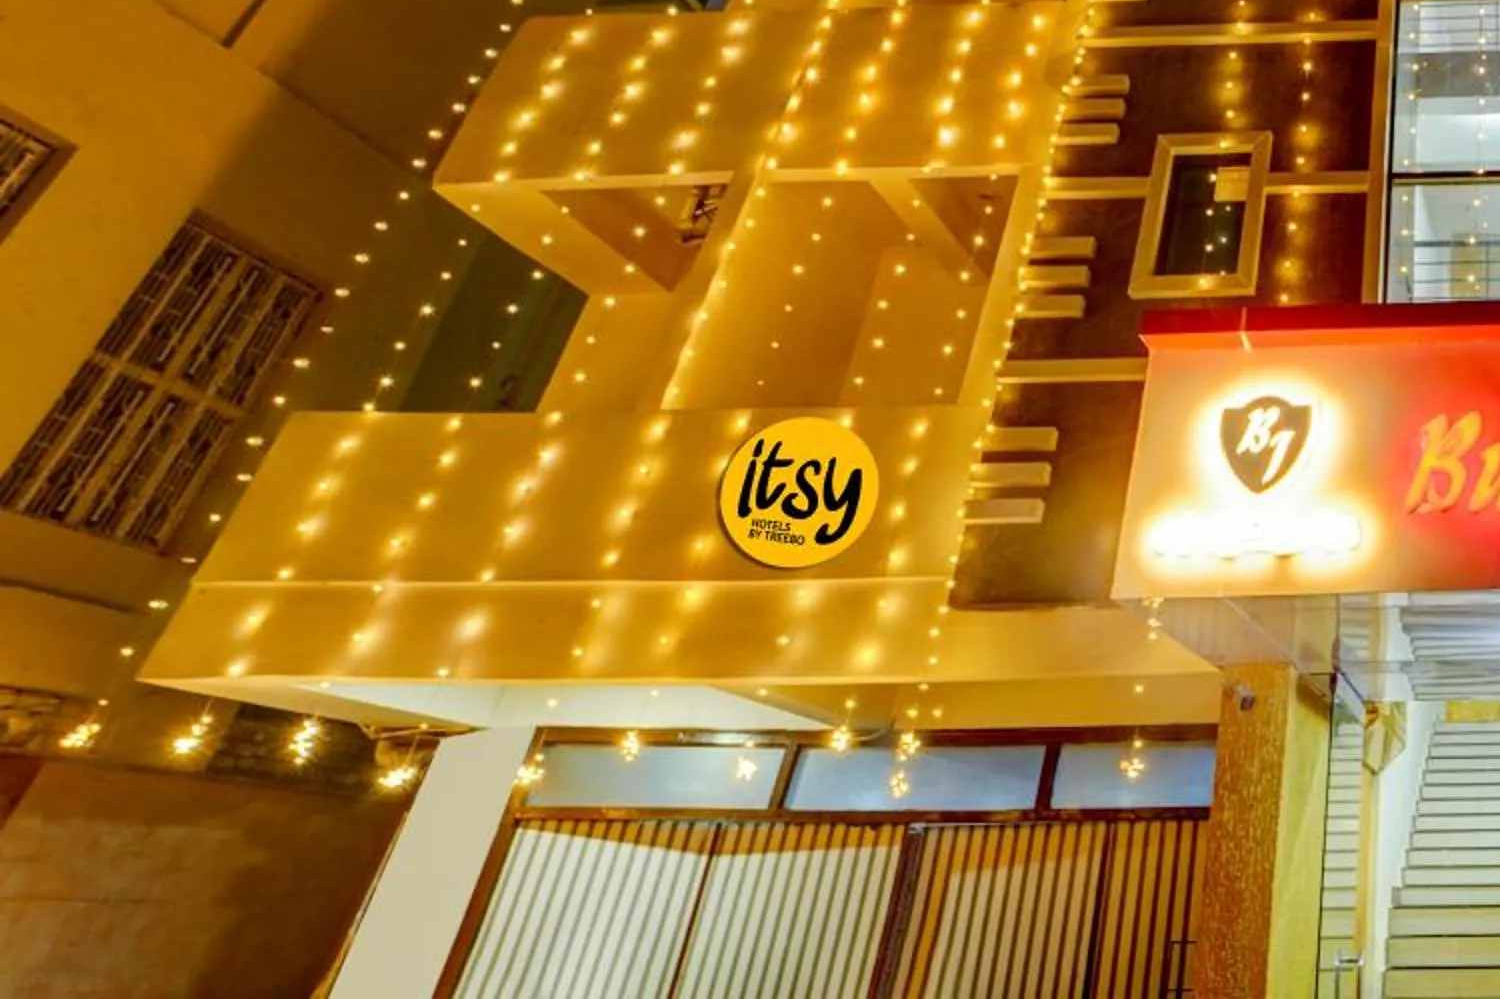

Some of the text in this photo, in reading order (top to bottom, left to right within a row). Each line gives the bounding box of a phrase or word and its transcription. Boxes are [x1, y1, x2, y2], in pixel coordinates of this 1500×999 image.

[738, 438, 863, 545] itsy
[751, 518, 791, 532] HOTELS
[748, 528, 805, 546] BY TREEBO
